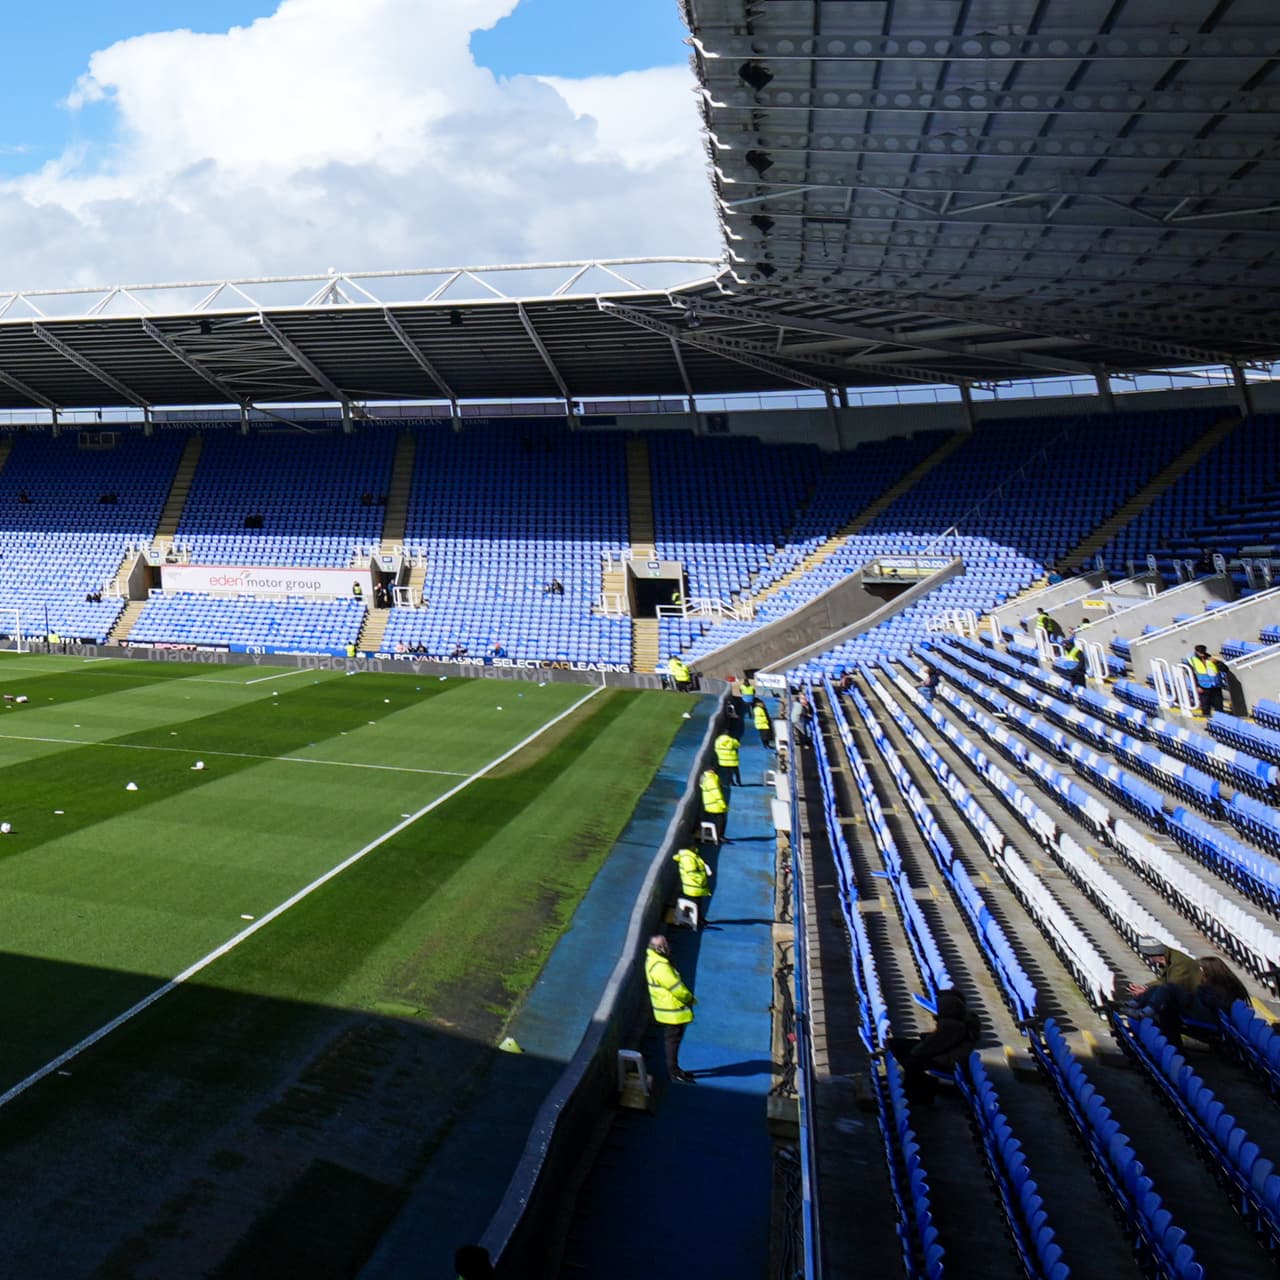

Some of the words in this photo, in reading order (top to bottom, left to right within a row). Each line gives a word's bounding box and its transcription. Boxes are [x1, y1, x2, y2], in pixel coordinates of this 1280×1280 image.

[210, 576, 244, 586] eden
[247, 578, 283, 588] motor
[286, 580, 321, 590] group
[148, 648, 227, 664] macron
[297, 655, 382, 672] macron
